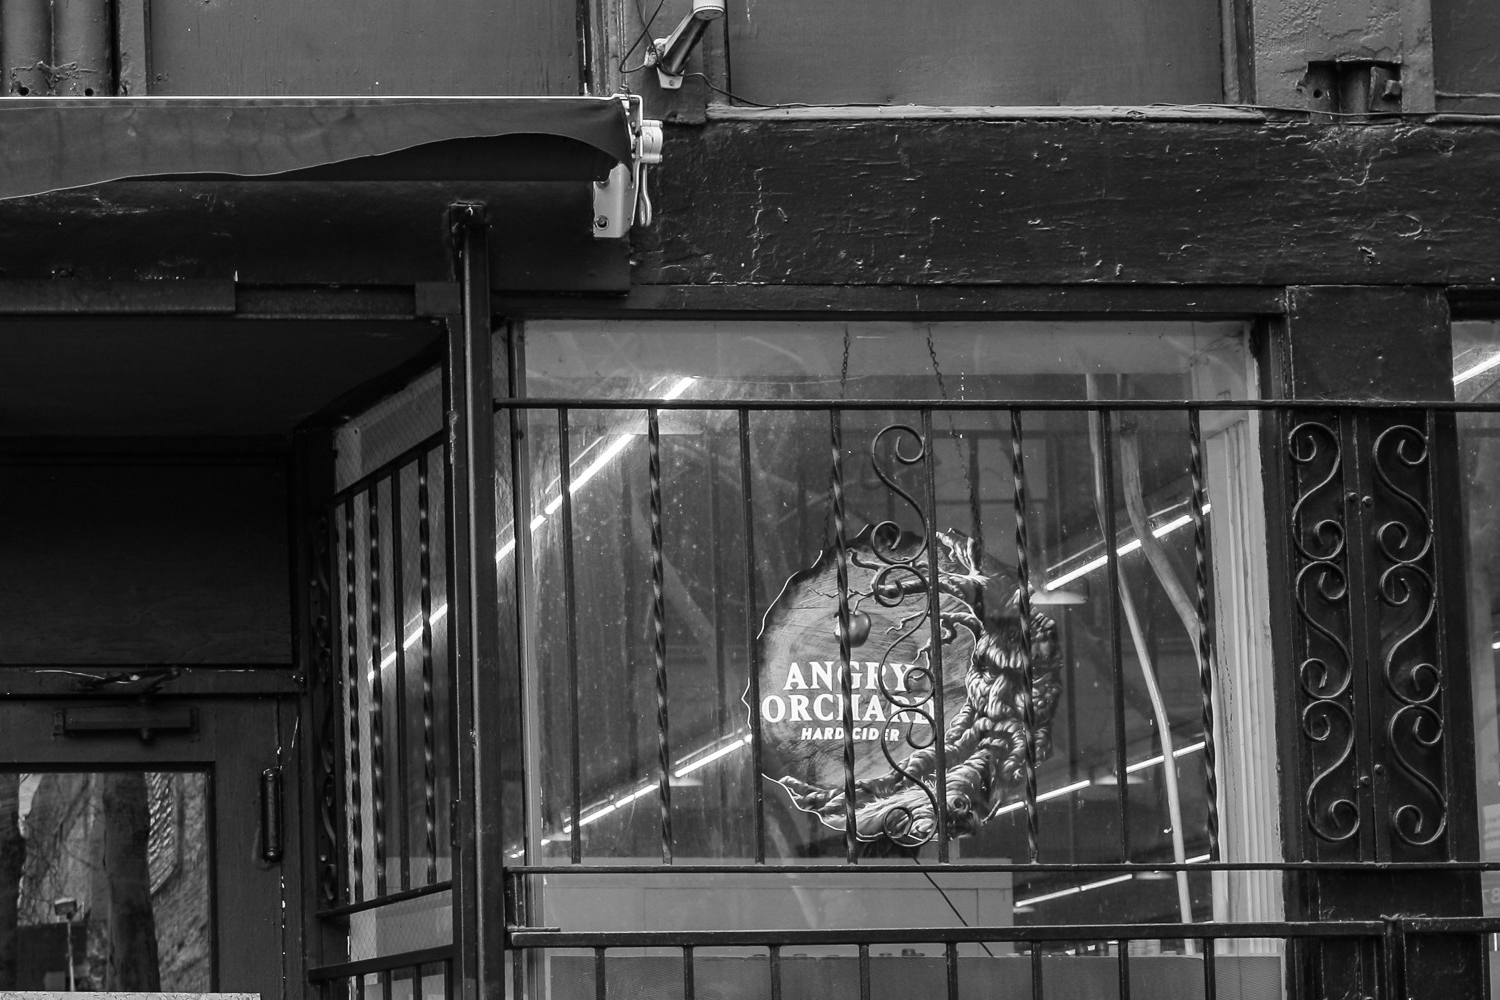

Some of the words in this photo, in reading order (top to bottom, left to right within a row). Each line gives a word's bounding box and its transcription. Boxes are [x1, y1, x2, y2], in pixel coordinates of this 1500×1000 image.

[783, 661, 915, 692] ANGRY
[762, 694, 934, 724] ORCHARD
[801, 727, 845, 741] HARD
